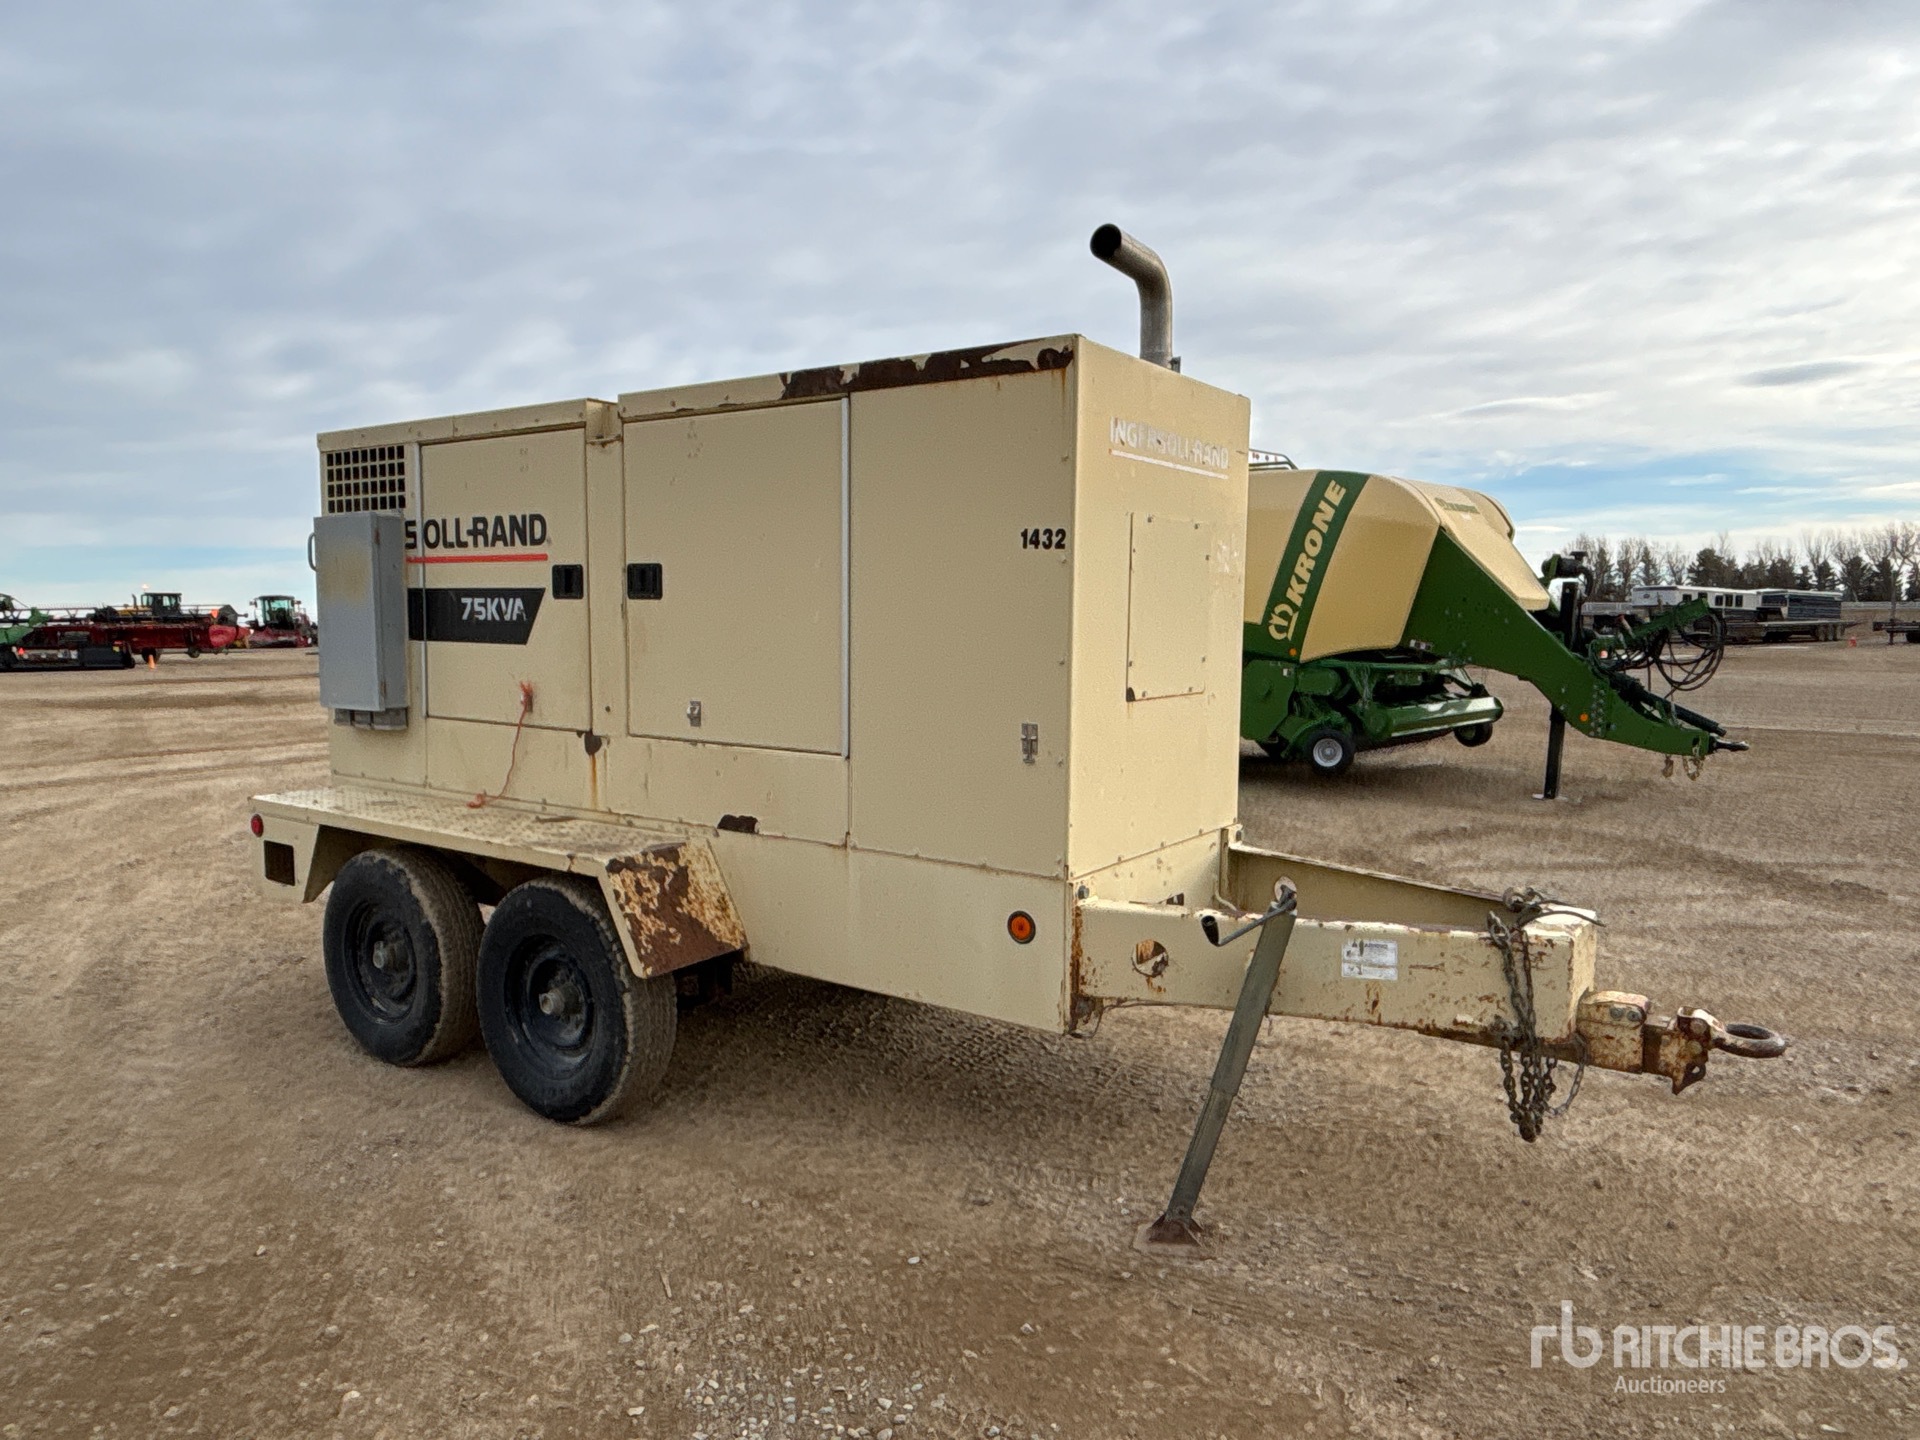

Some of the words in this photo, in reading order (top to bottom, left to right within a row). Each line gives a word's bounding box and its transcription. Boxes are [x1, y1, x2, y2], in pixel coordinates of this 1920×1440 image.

[1021, 528, 1066, 550] 1432
[1286, 480, 1346, 606] KRONE
[461, 597, 526, 621] 75KVA
